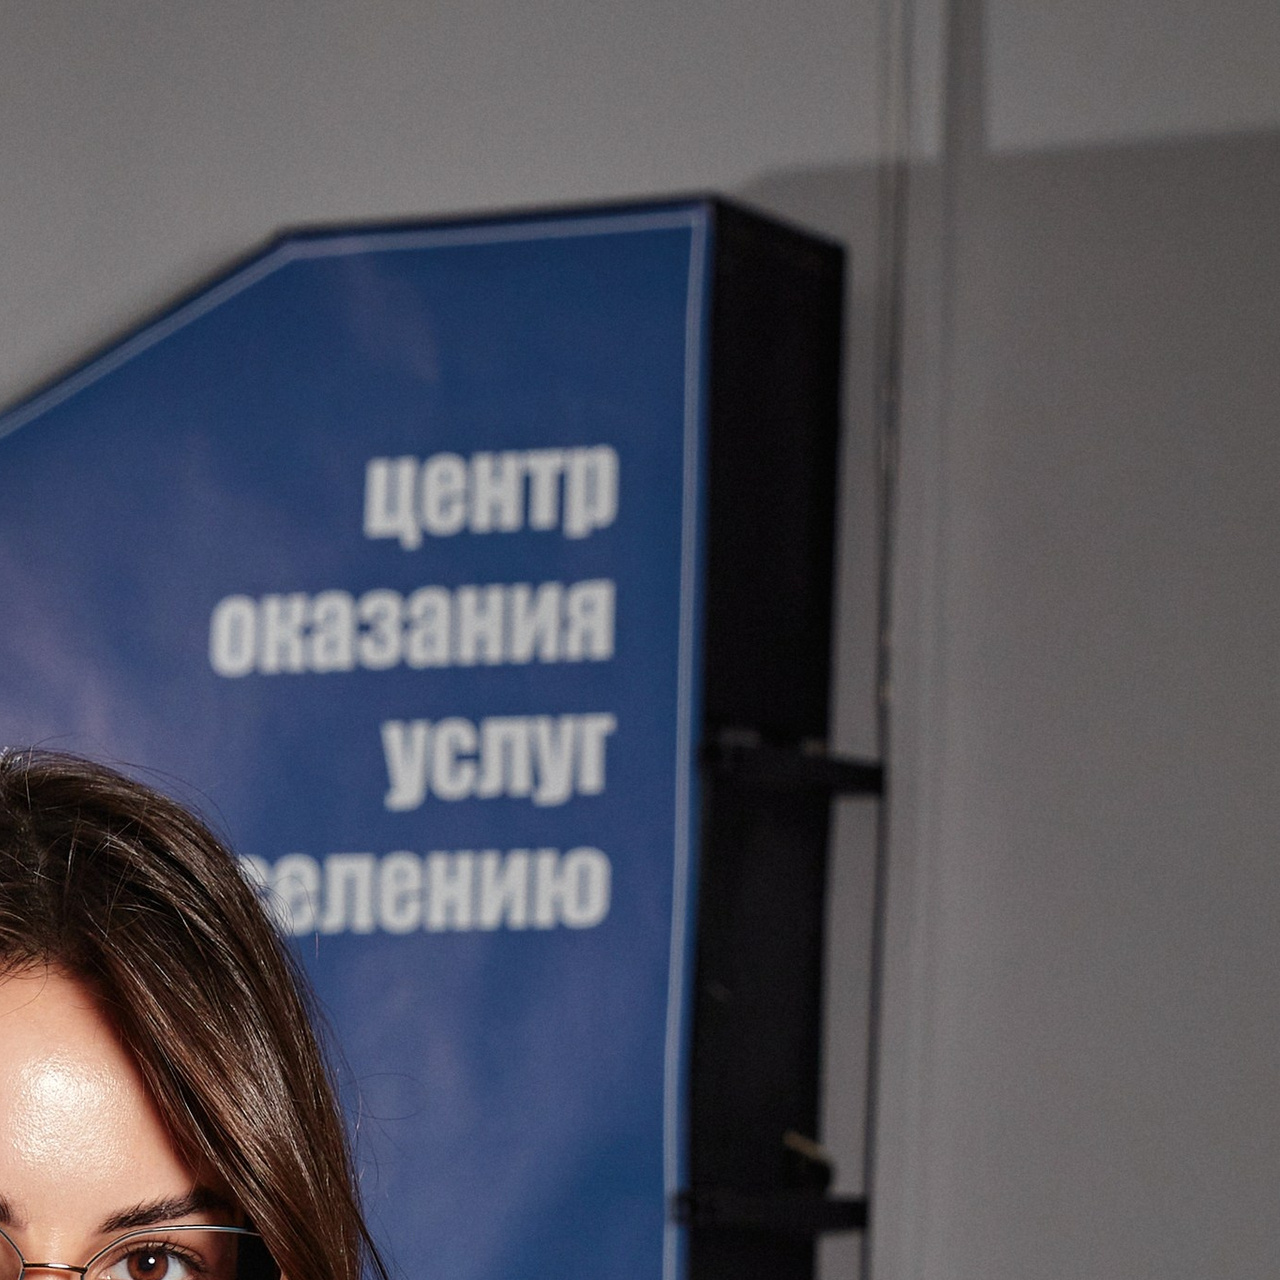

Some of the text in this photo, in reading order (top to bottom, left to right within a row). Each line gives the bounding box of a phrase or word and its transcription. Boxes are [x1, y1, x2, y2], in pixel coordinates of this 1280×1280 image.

[363, 443, 618, 551] центр
[208, 578, 616, 678] оказания
[380, 711, 618, 811] услуг
